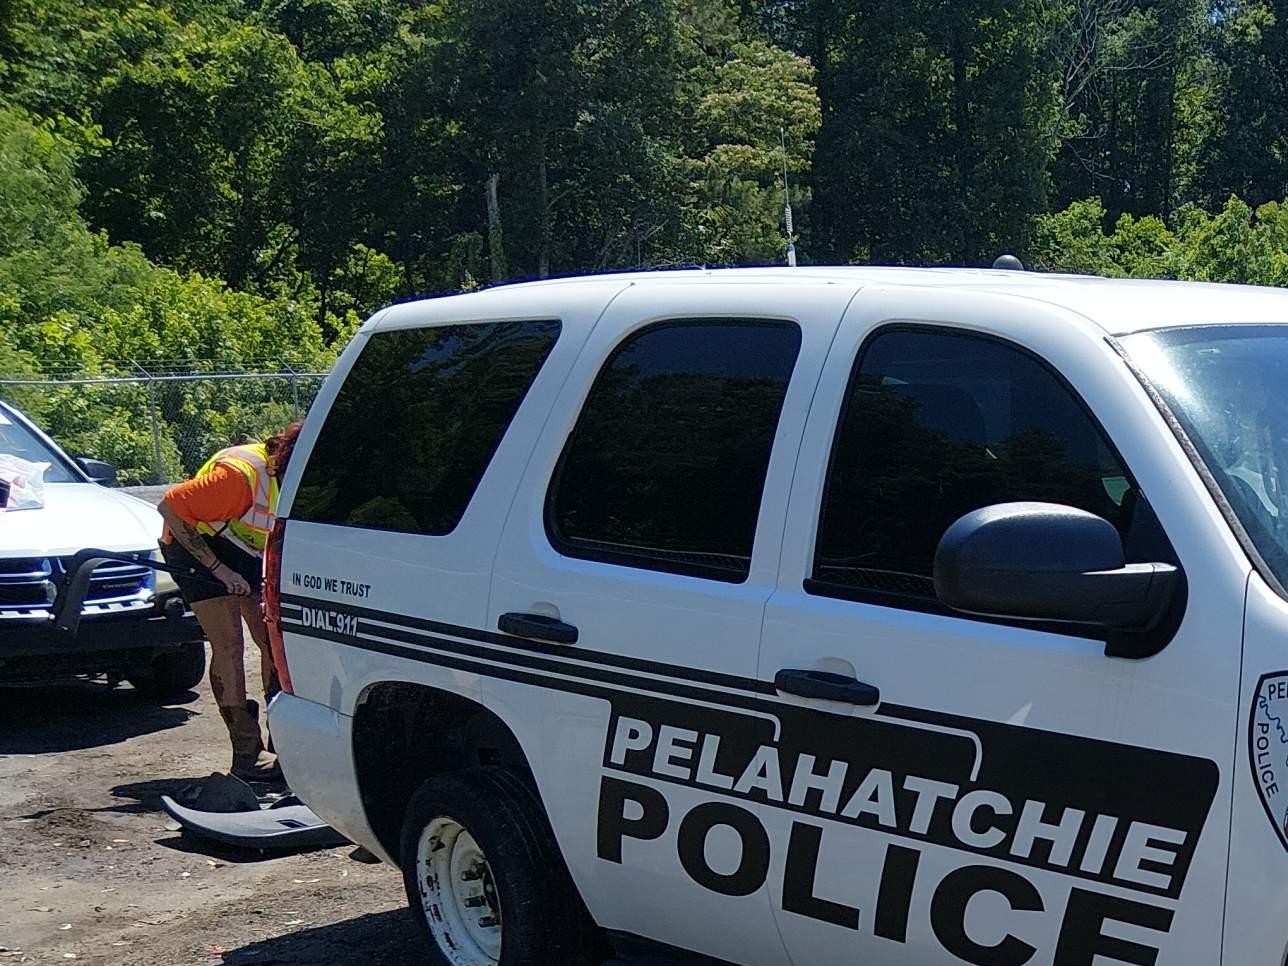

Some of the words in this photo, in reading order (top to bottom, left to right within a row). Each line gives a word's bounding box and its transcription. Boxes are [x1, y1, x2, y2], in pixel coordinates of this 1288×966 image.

[292, 572, 302, 586] IN
[303, 574, 322, 590] GOD
[324, 577, 338, 593] WE
[340, 580, 371, 598] TRUST
[302, 607, 334, 632] DIAL
[335, 613, 358, 637] 911
[1256, 721, 1279, 799] POLICE
[609, 714, 1188, 890] PELAHATCHIE
